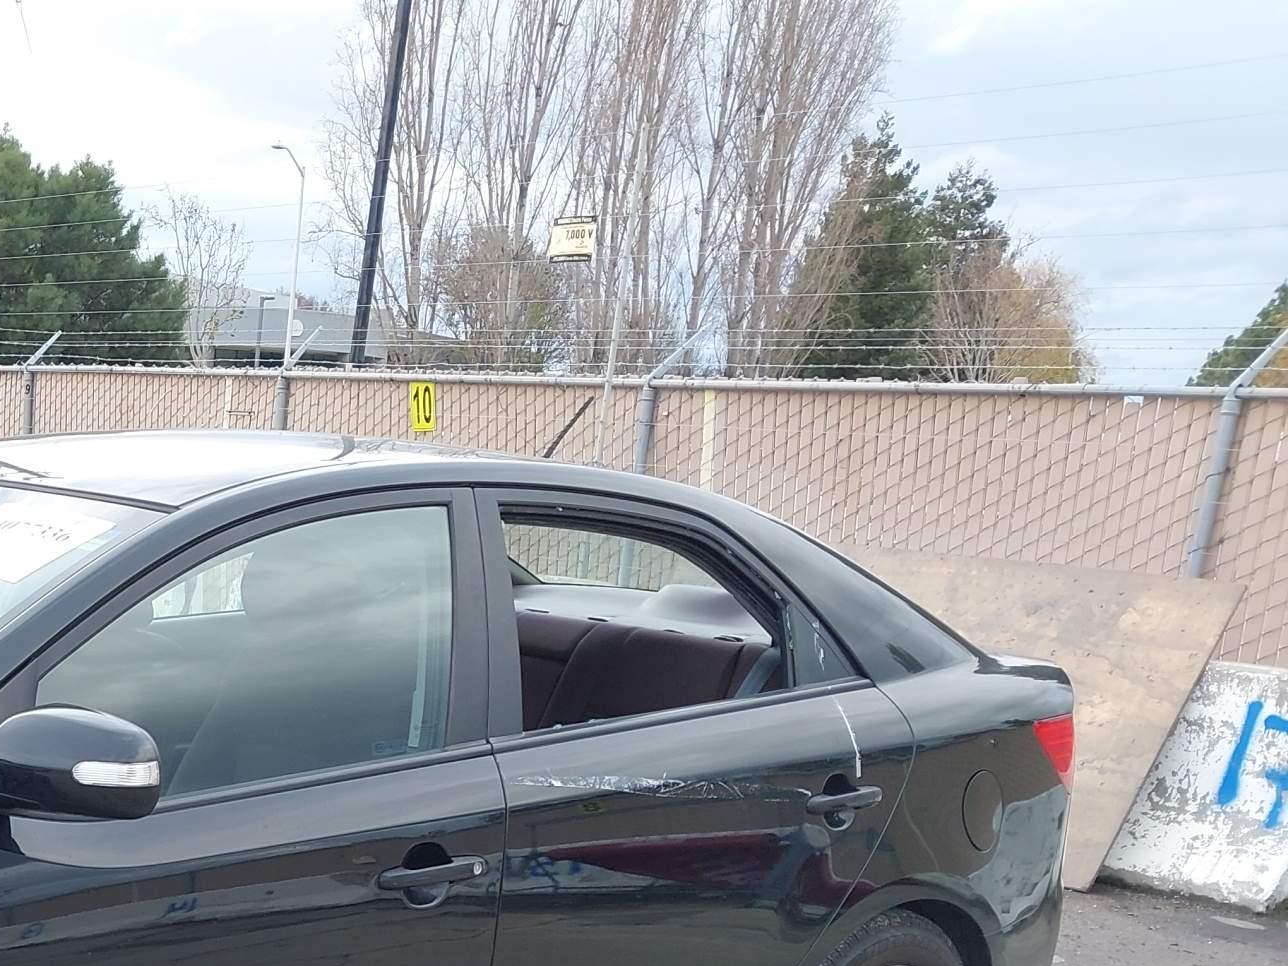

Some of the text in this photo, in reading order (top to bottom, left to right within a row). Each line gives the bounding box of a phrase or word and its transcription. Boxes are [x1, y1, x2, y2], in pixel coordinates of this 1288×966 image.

[565, 228, 594, 241] 7,000 V
[25, 384, 31, 395] 9
[413, 385, 432, 424] 10
